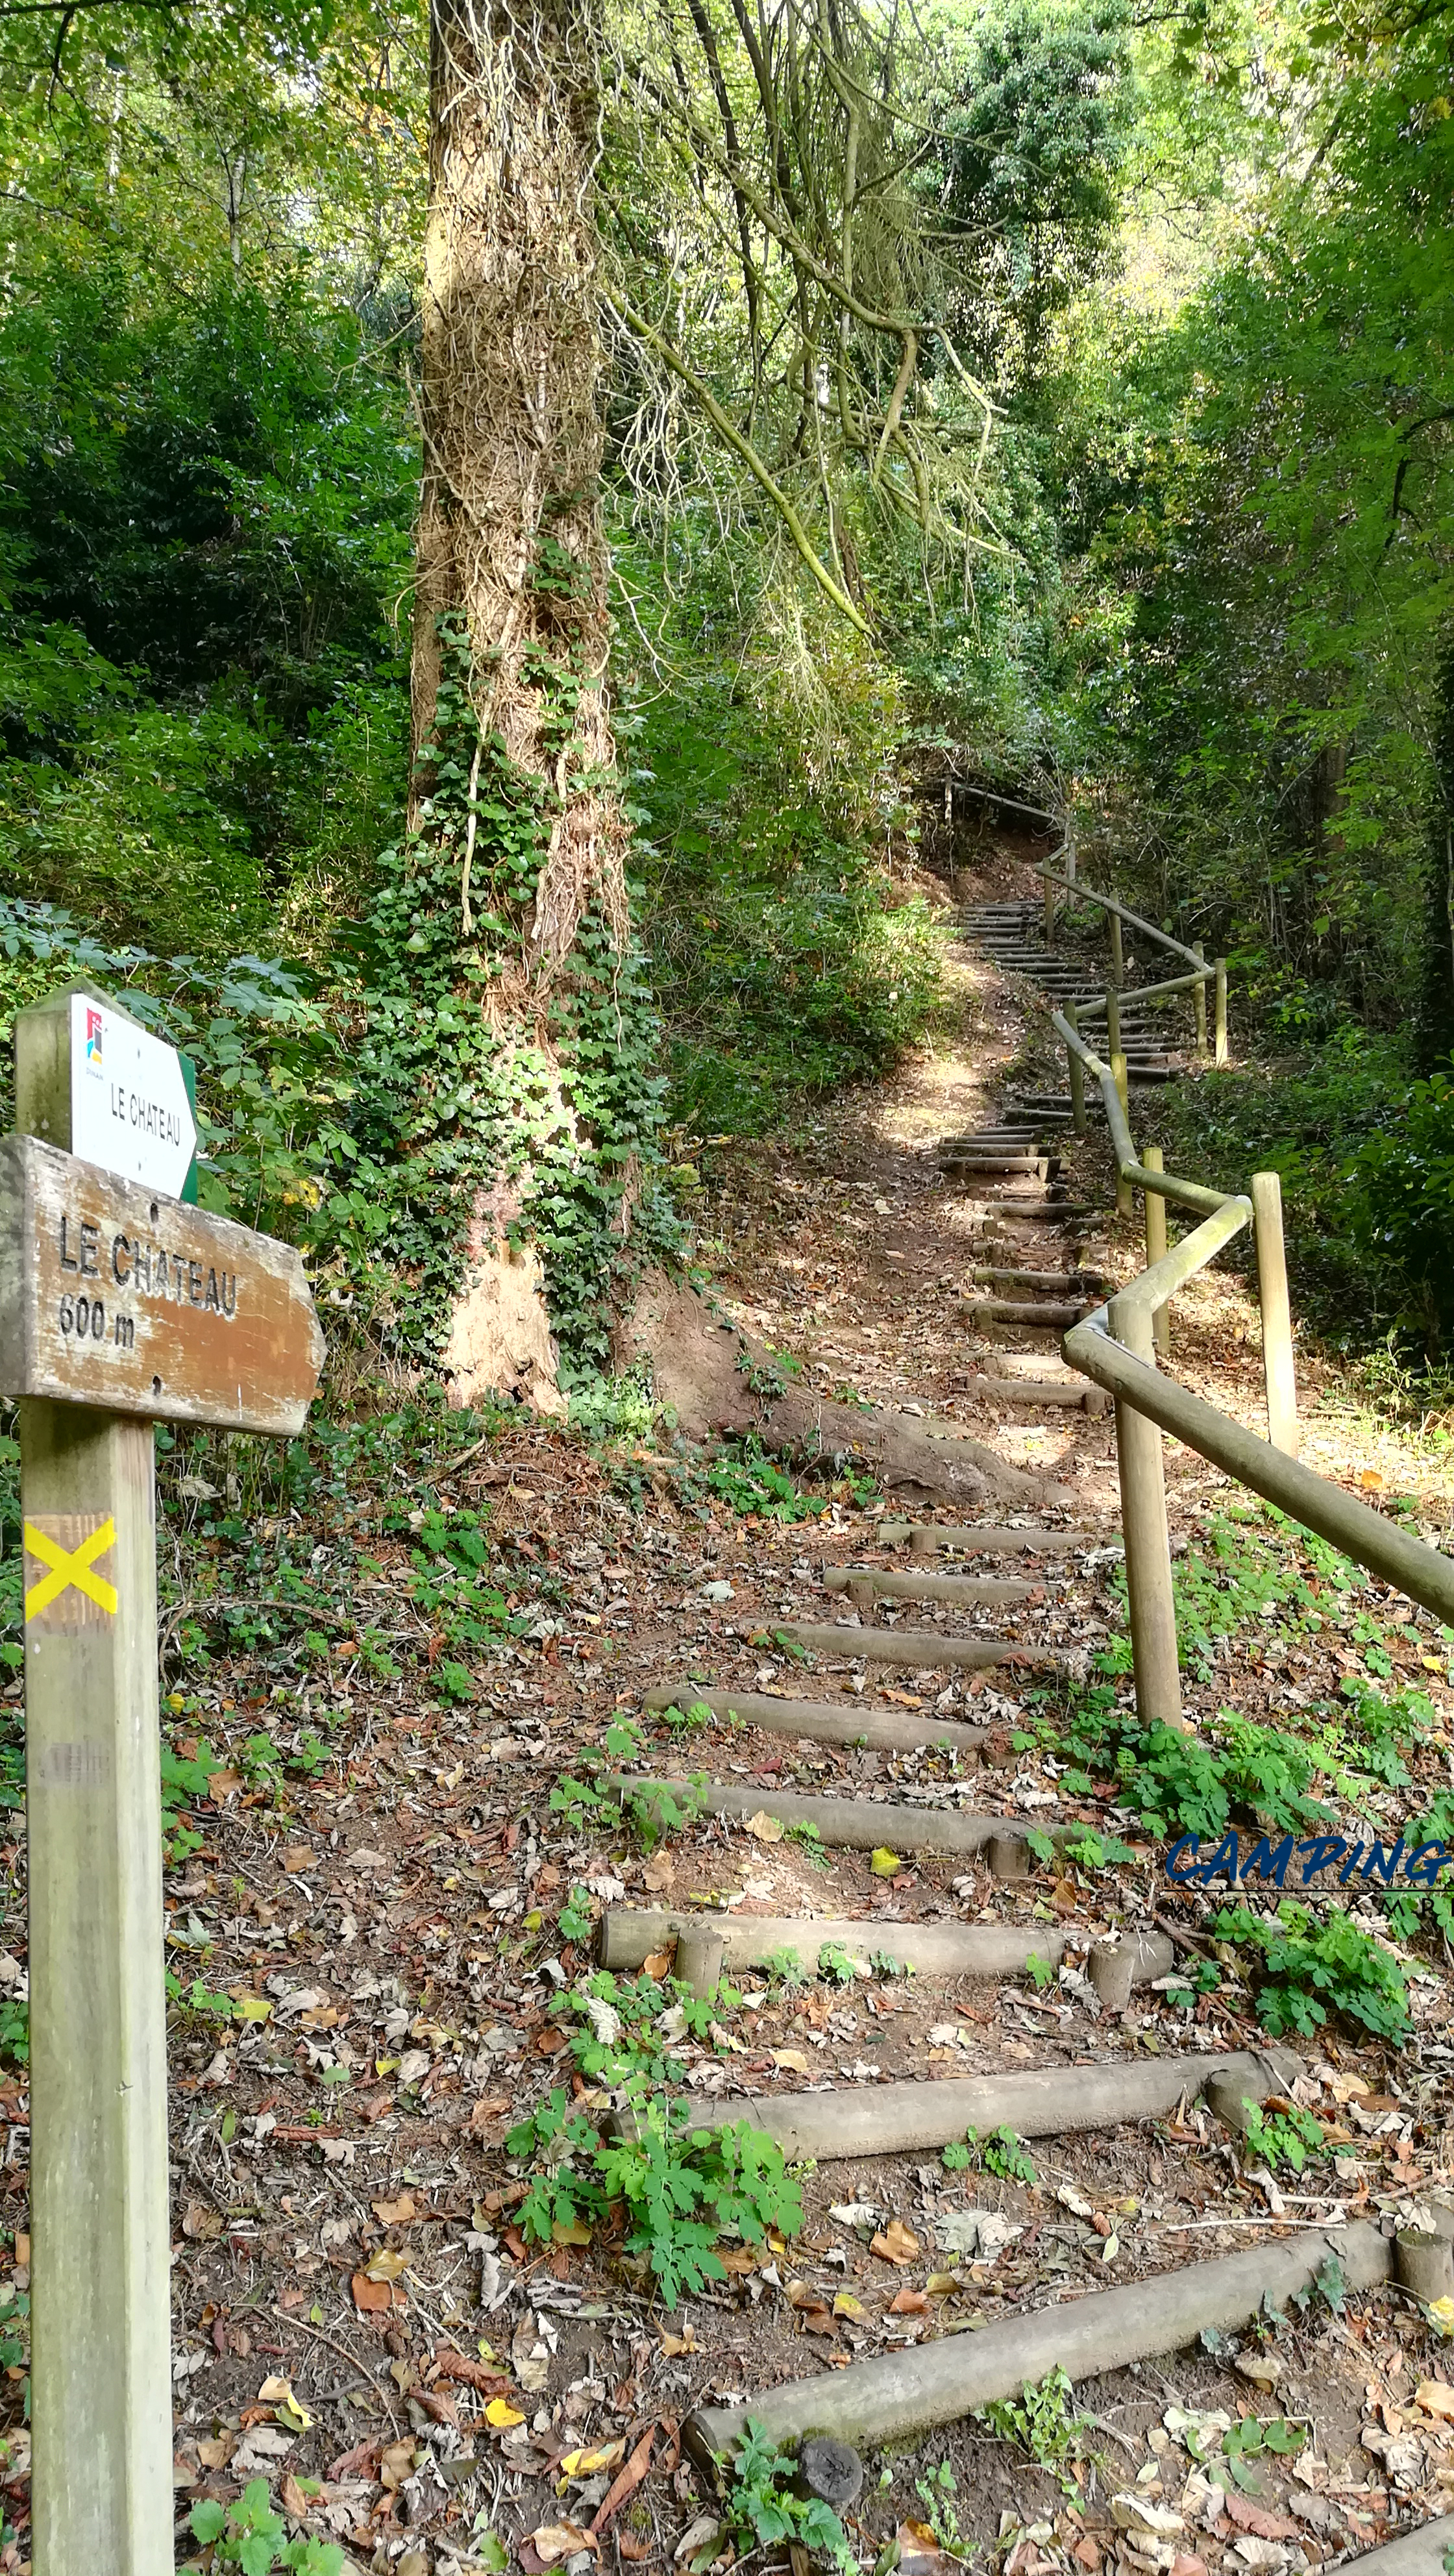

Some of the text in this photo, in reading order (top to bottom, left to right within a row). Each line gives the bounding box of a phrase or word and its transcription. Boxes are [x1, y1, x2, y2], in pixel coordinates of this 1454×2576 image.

[111, 1083, 181, 1146] LE CHATEAU
[60, 1216, 236, 1316] LE CHATEAU
[60, 1293, 134, 1348] 600 m
